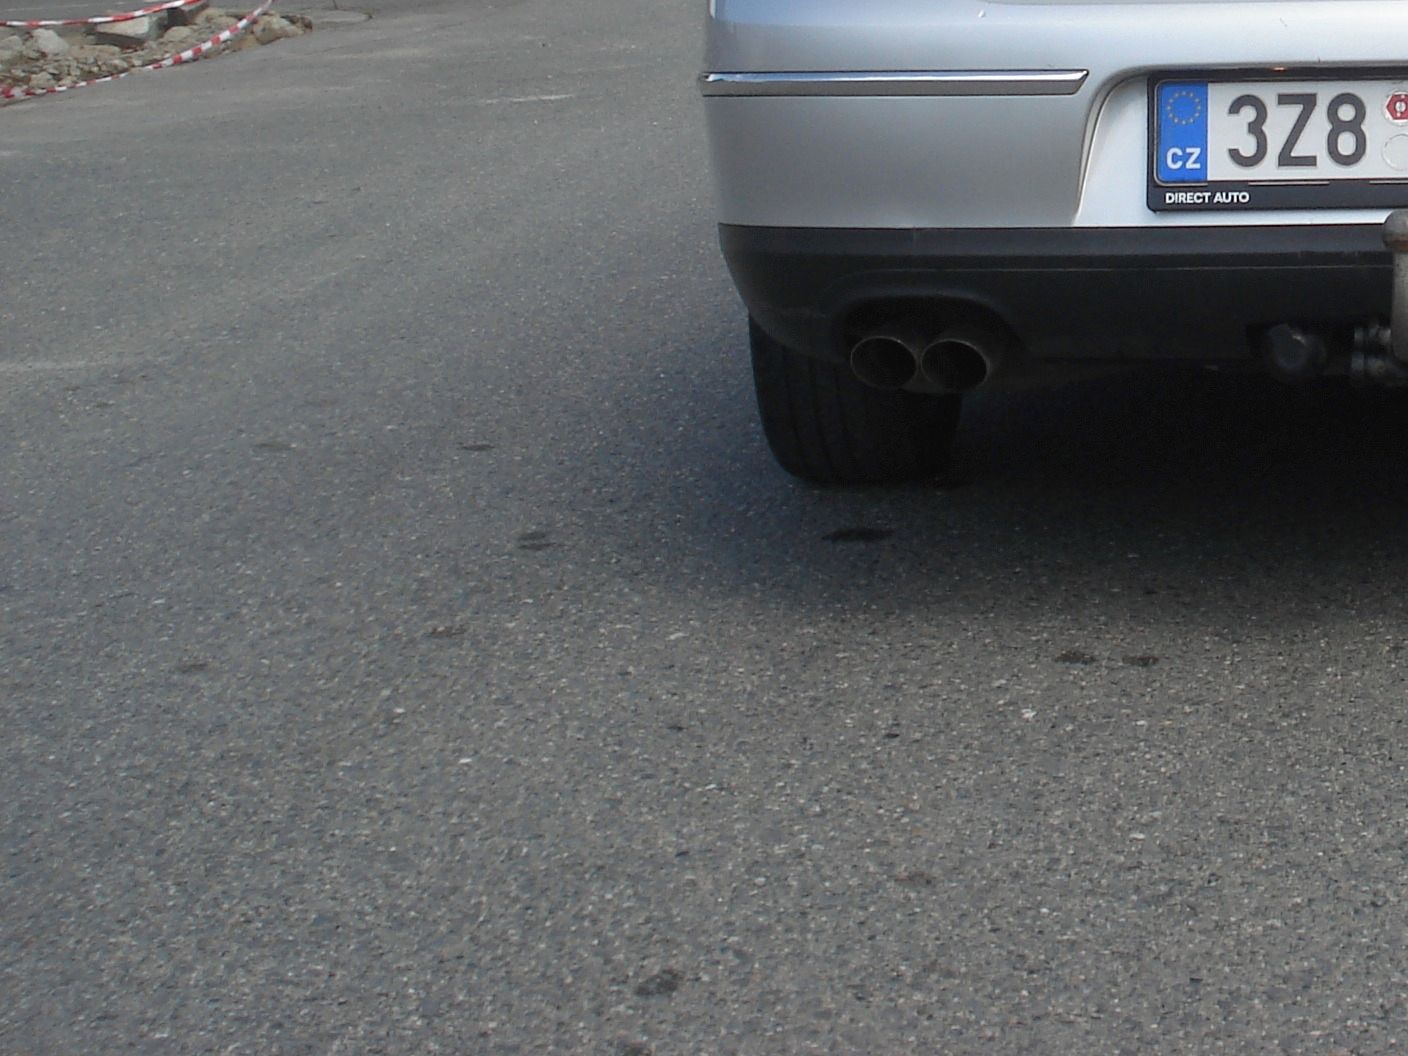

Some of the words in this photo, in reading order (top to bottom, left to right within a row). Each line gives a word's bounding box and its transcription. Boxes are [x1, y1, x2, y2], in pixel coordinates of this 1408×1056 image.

[1226, 92, 1368, 168] 3Z8
[1166, 147, 1201, 170] CZ
[1165, 192, 1211, 204] DIRECT
[1213, 192, 1250, 204] AUTO
